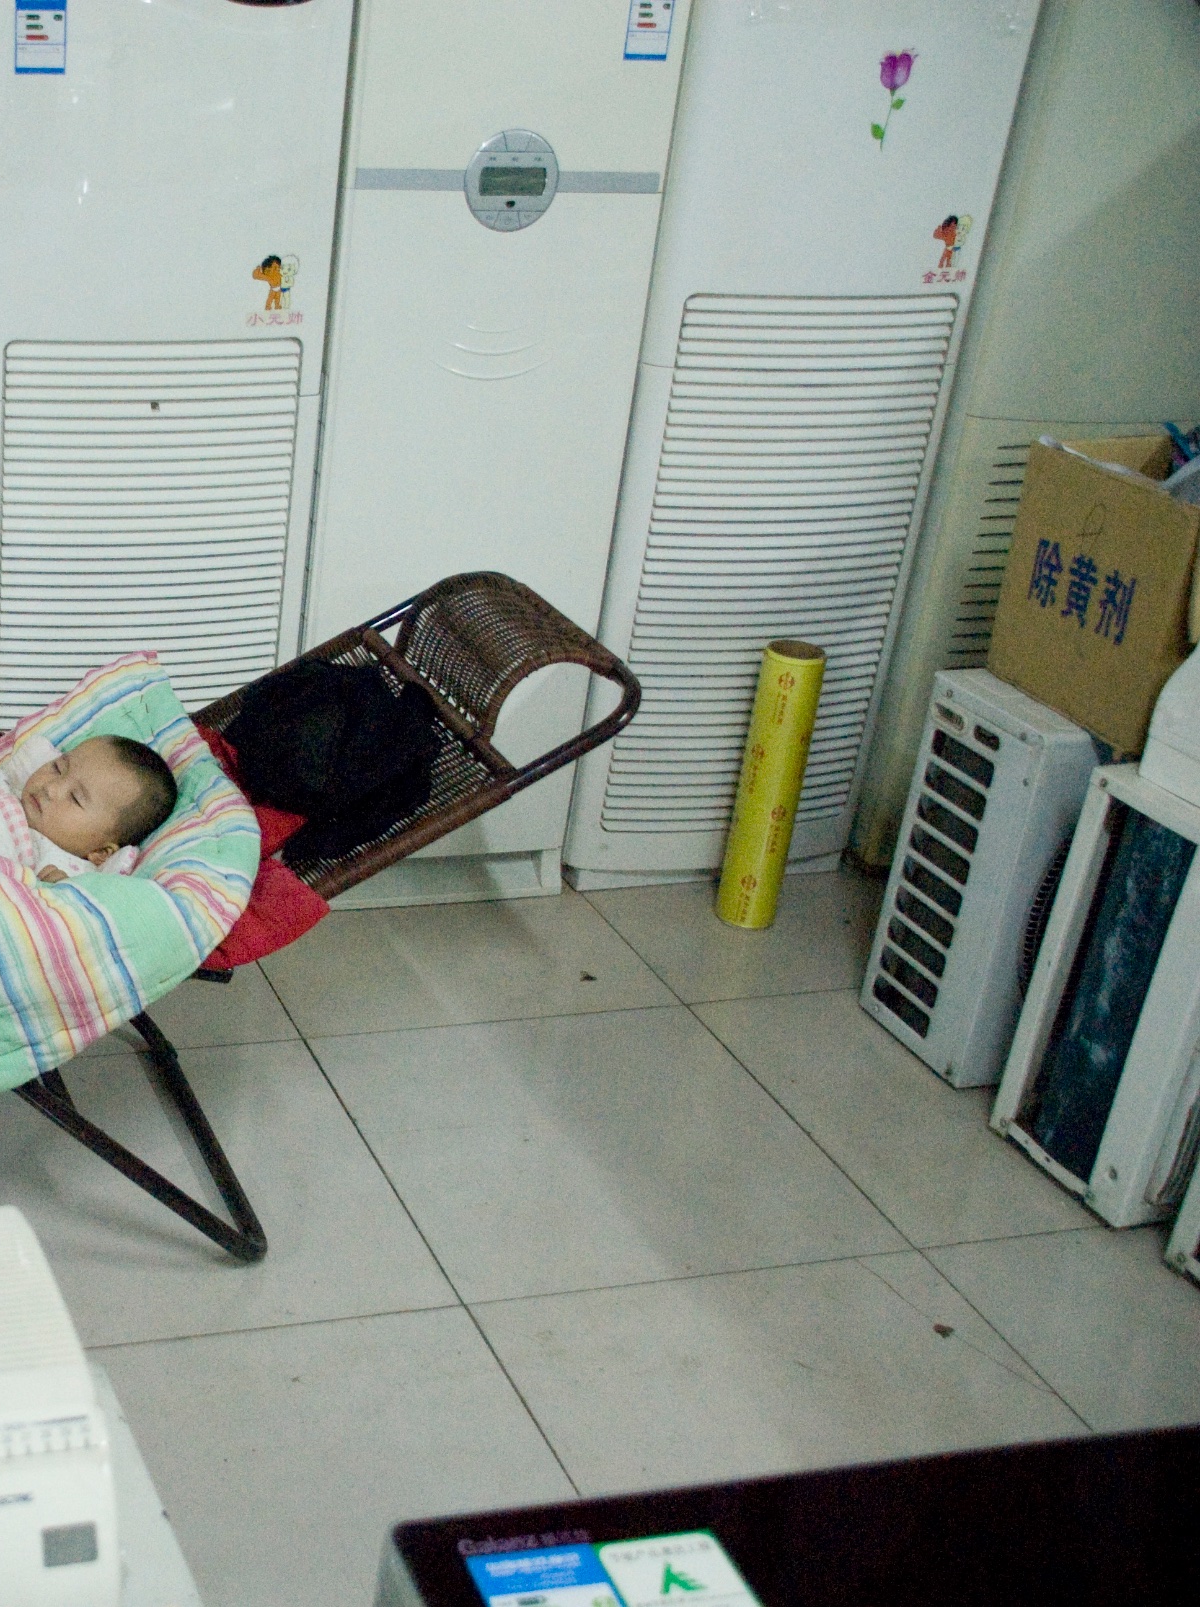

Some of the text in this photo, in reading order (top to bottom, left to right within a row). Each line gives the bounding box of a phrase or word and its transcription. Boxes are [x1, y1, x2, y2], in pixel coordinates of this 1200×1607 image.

[247, 311, 303, 326] 小元帅
[1028, 538, 1137, 646] 除黄剂
